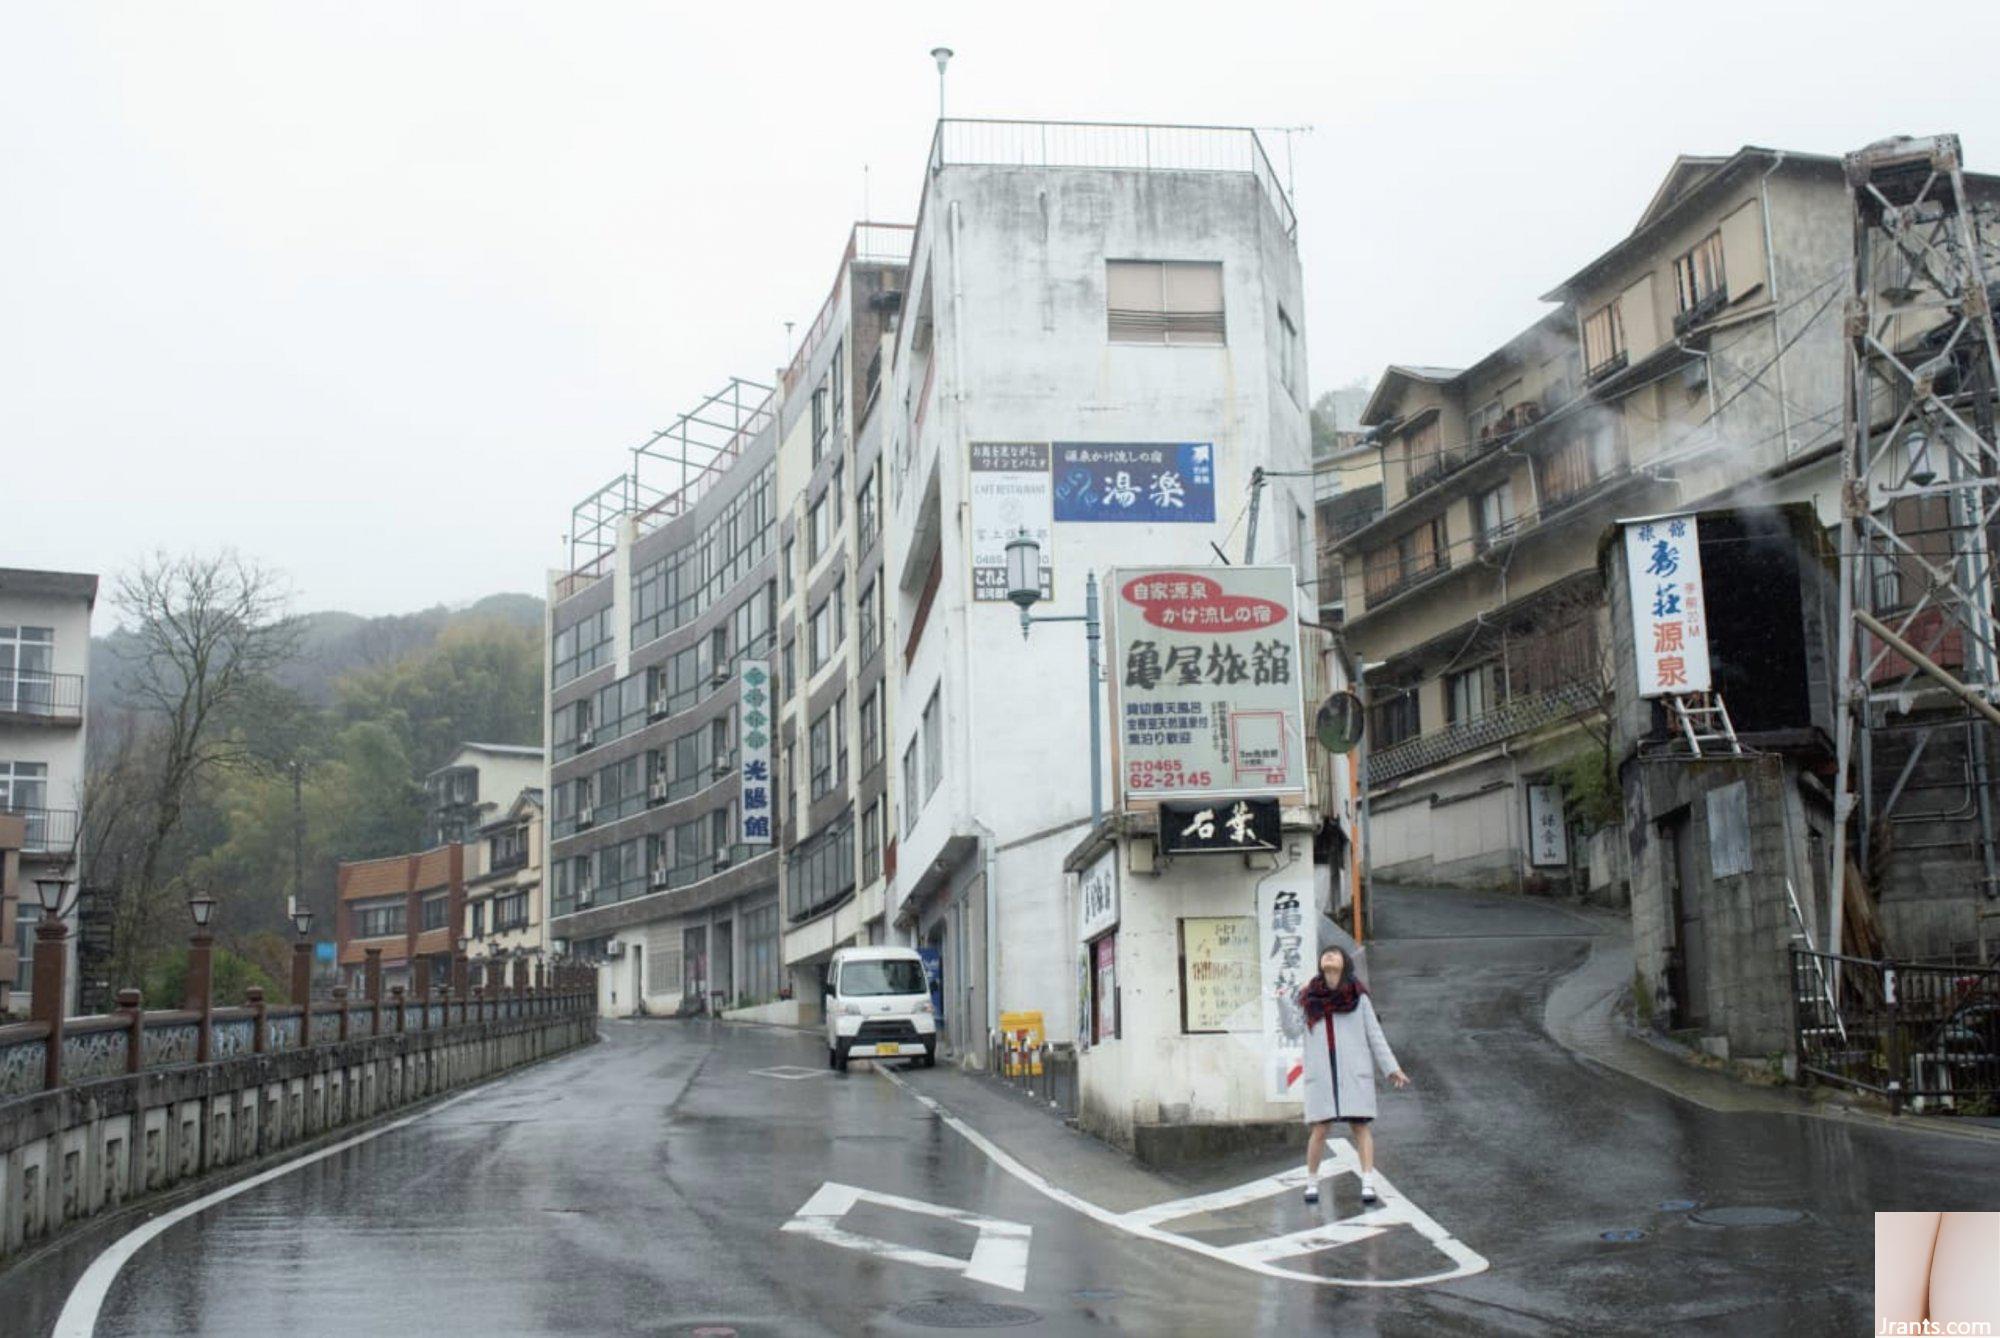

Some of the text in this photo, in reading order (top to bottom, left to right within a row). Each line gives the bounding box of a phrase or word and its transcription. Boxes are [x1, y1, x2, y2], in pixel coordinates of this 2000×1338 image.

[1134, 582, 1208, 600] 自家源泉
[1162, 604, 1273, 623] かけ流しの宿
[1653, 621, 1688, 687] 源泉
[1143, 760, 1183, 773] 0465
[1129, 771, 1212, 789] 62-2145
